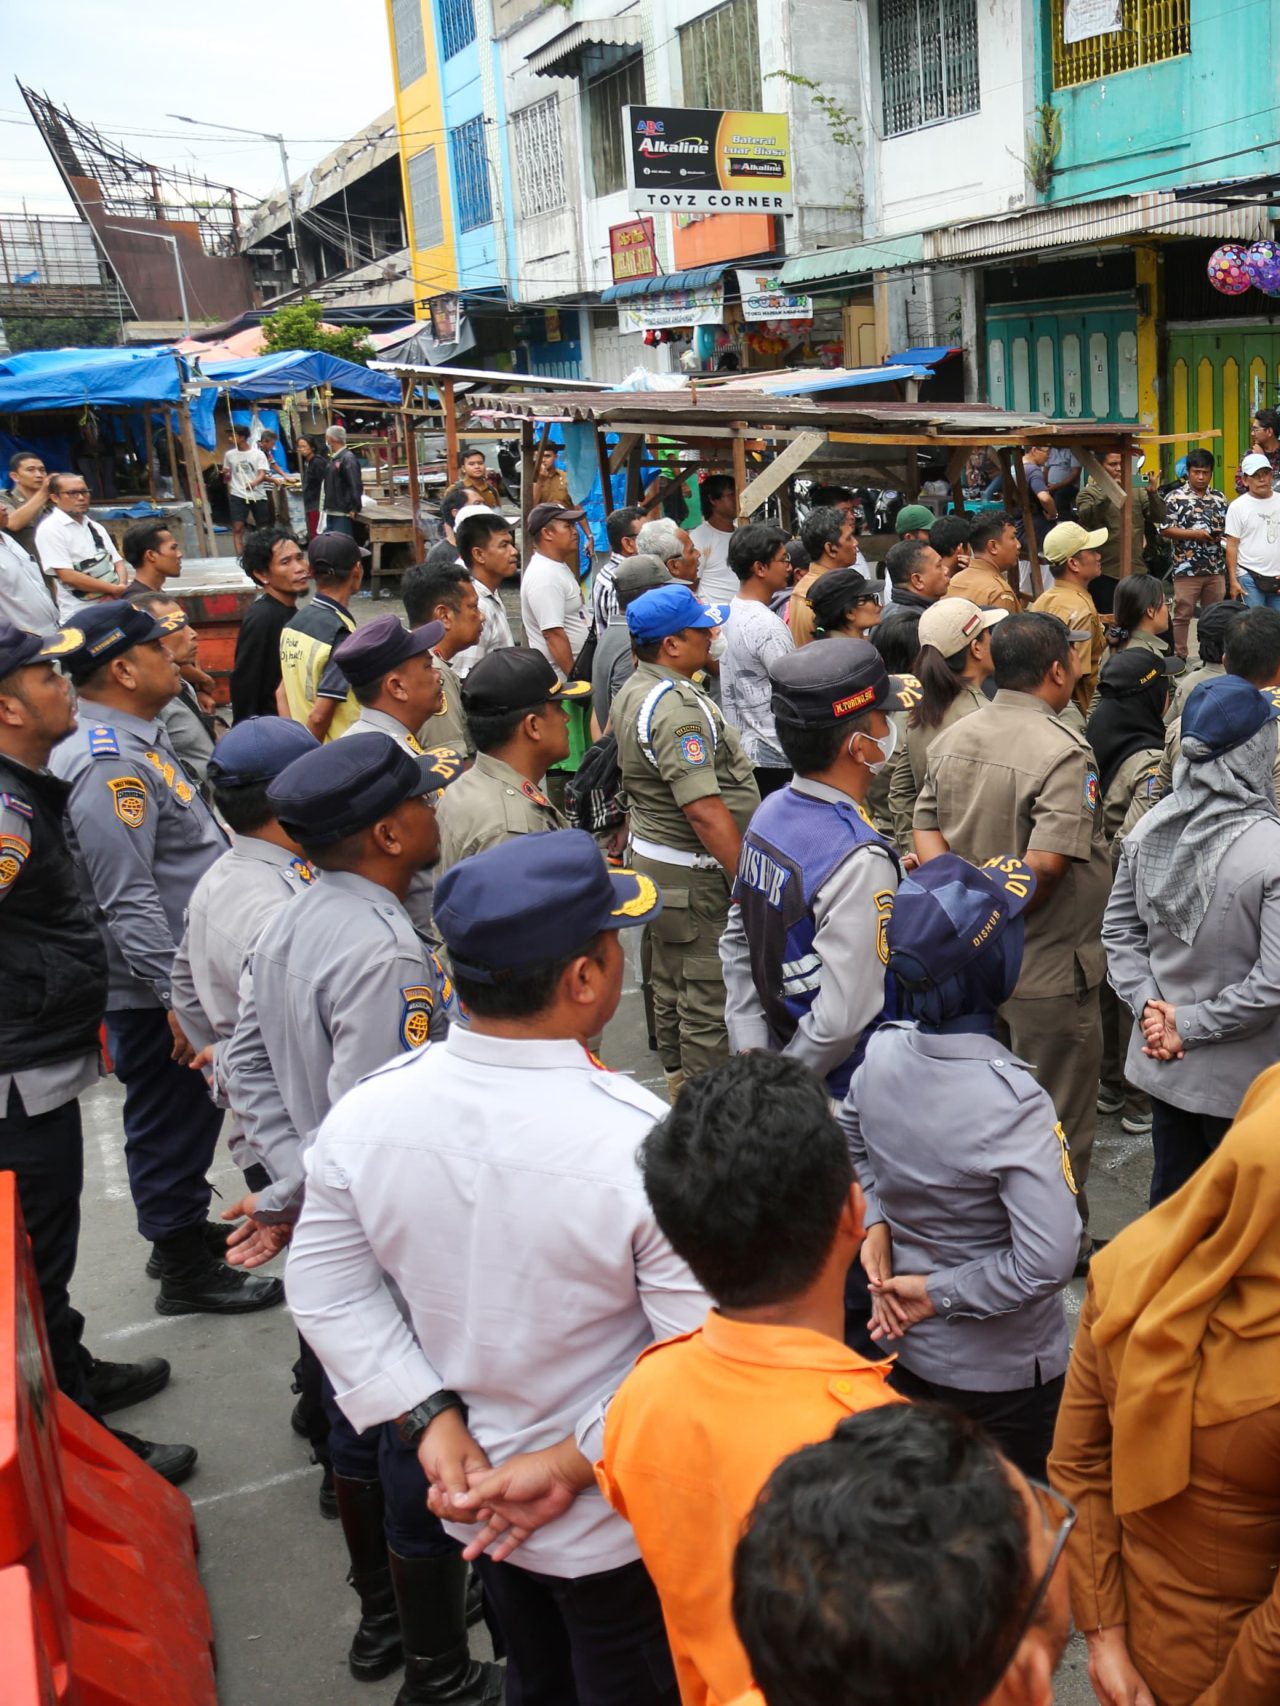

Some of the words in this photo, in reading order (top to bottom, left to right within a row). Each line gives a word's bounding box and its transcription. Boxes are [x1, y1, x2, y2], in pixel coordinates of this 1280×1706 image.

[637, 120, 665, 131] ABC
[638, 137, 709, 154] Alkaline
[732, 135, 776, 146] Baterai
[723, 146, 750, 155] Luar
[753, 147, 785, 156] Biasa
[647, 194, 697, 206] TOYZ
[708, 195, 783, 208] CORNER
[973, 910, 1000, 947] DISHUB
